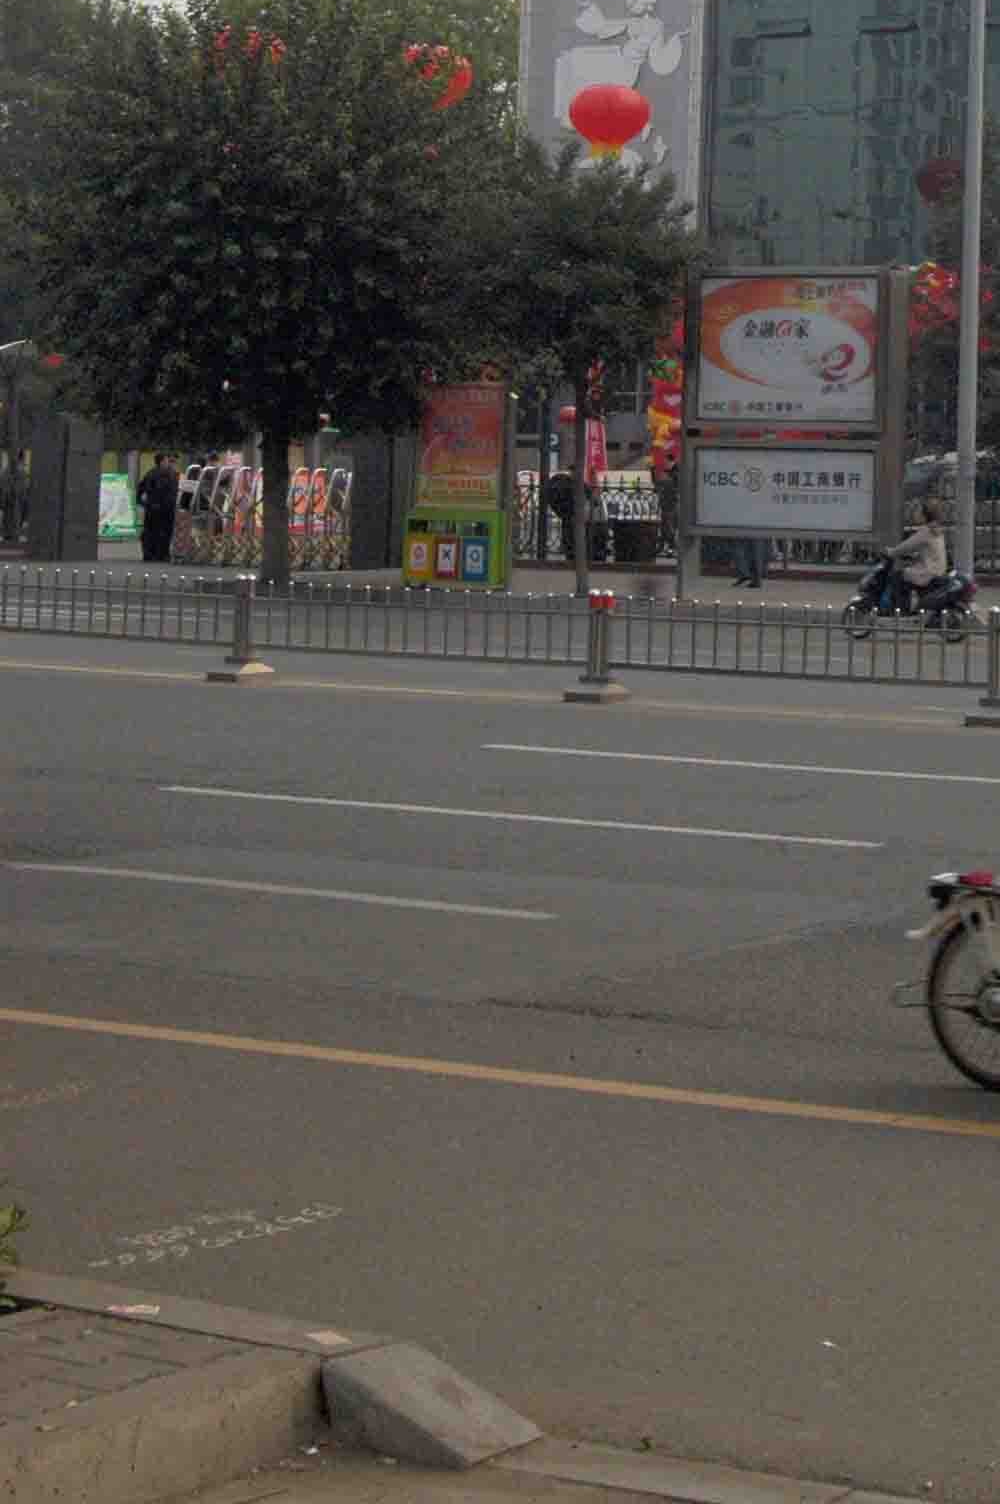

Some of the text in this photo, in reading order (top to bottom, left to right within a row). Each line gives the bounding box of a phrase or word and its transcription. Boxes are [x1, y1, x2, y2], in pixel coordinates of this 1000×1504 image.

[703, 471, 863, 489] ICBC 中国工商银行
